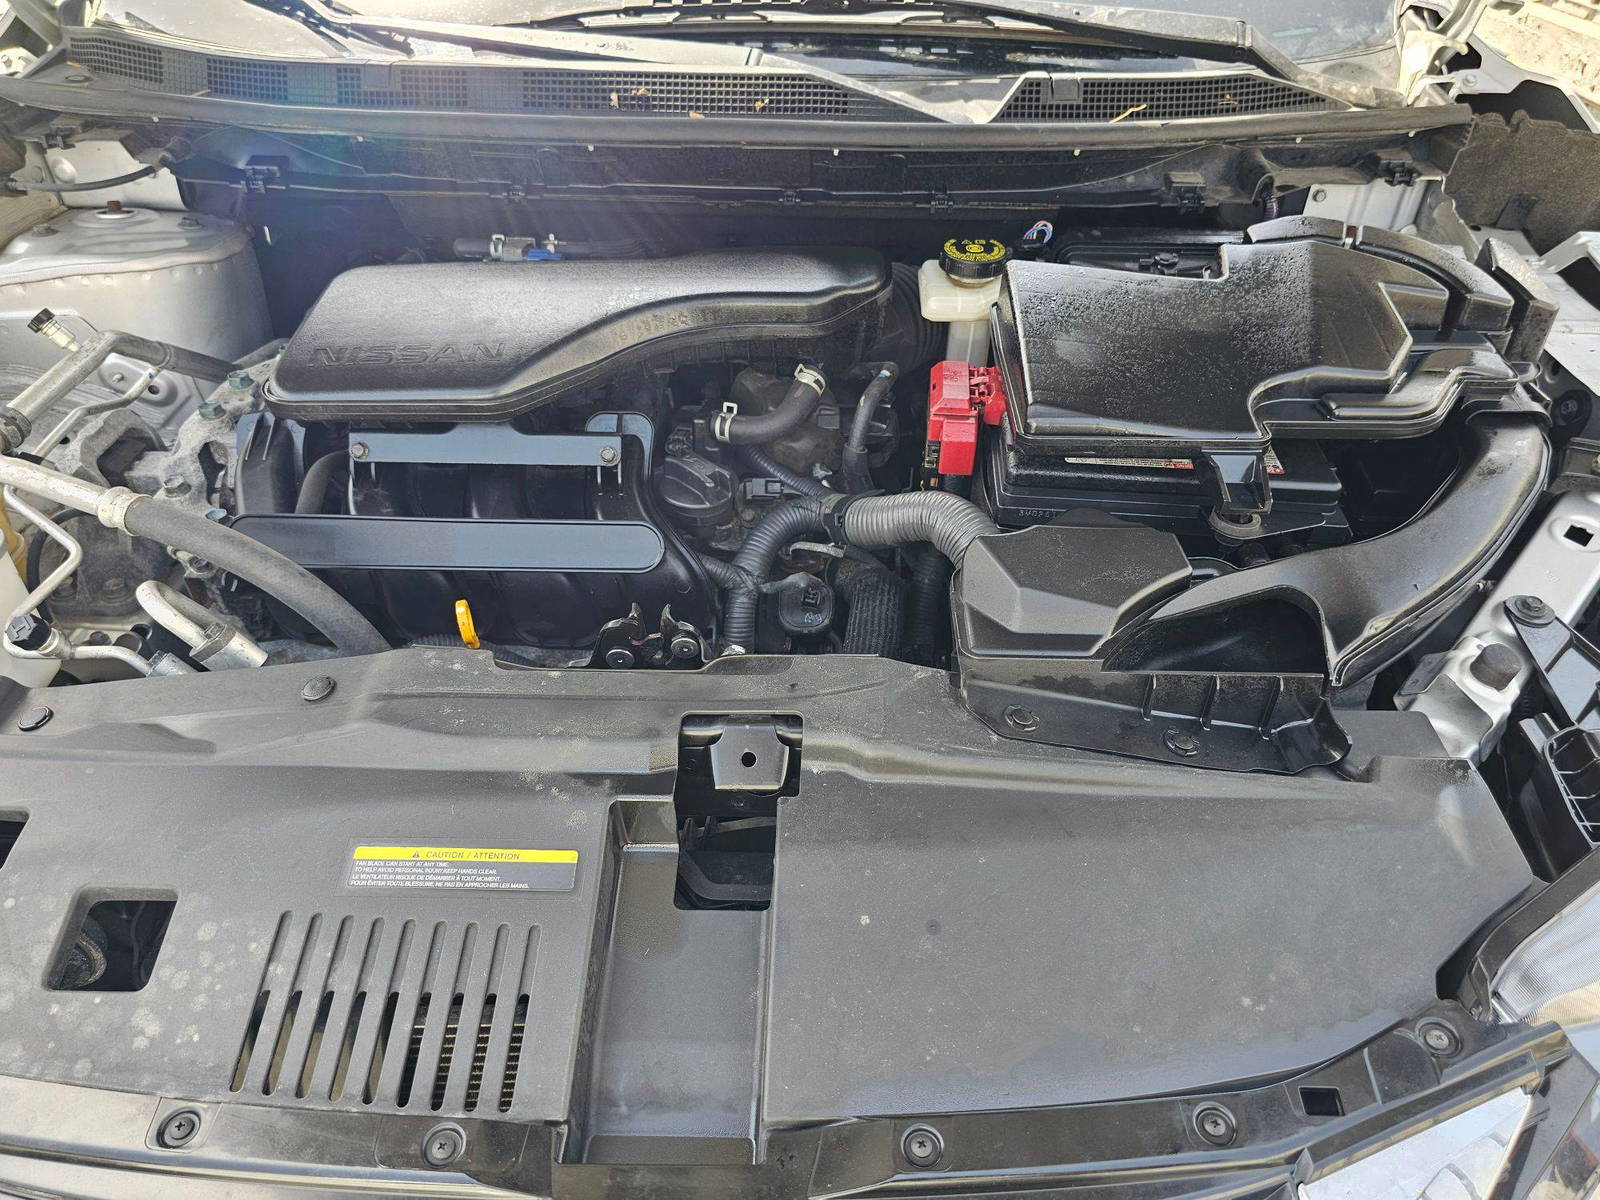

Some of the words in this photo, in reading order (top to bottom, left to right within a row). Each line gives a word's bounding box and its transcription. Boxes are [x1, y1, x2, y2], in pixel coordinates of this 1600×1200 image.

[308, 343, 505, 366] NISSAN
[426, 851, 464, 859] CAUTION
[473, 852, 520, 860] ATTENTION
[425, 873, 456, 881] DÉMARRER
